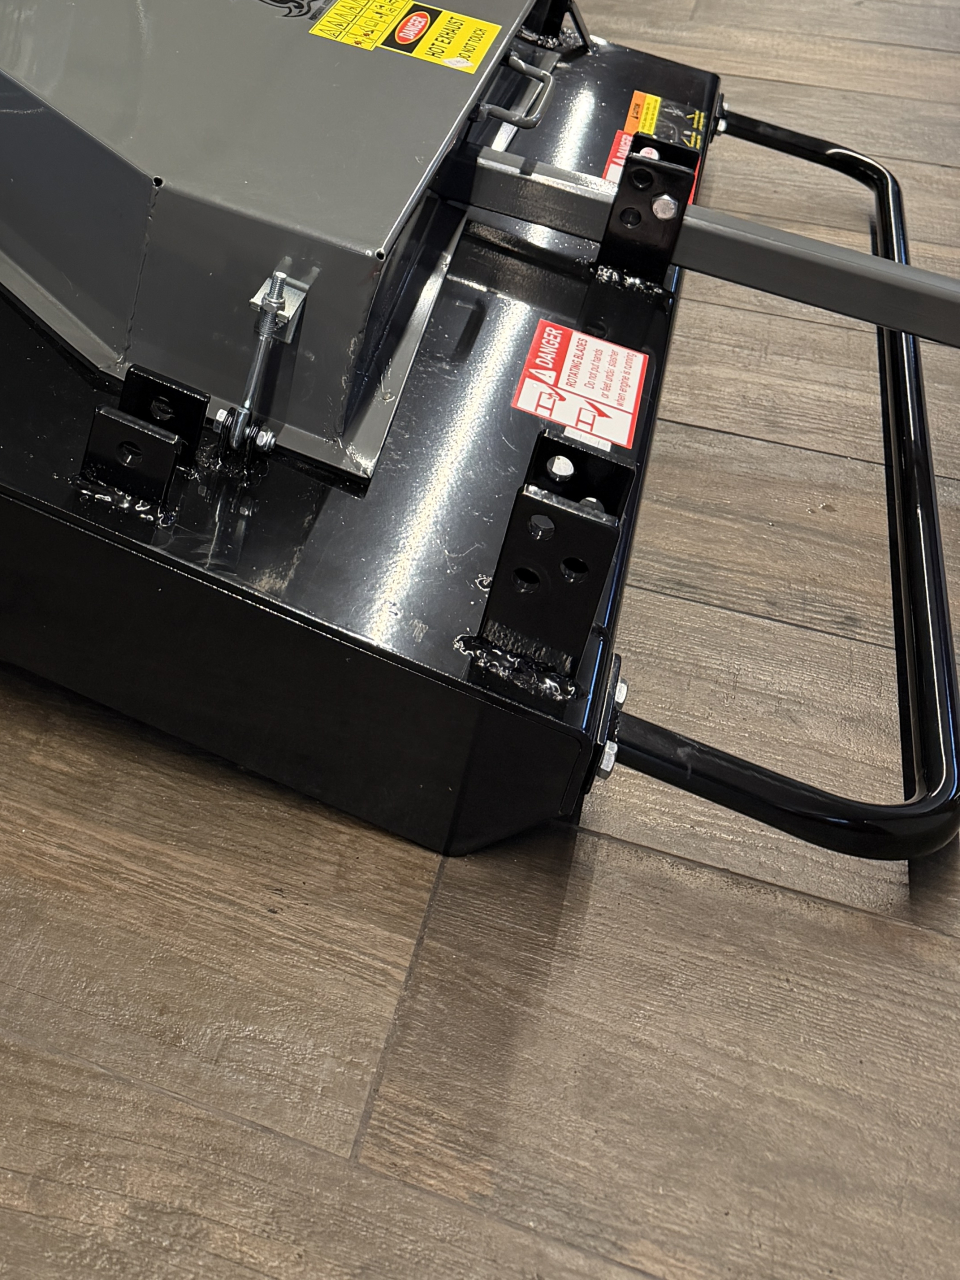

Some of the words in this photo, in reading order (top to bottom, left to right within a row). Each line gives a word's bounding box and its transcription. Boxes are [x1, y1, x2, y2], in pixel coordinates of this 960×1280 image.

[399, 15, 427, 39] DANGER
[425, 42, 447, 58] HOT
[440, 16, 465, 44] EXHAUST
[462, 41, 477, 54] NOT
[470, 27, 487, 44] TOUCH
[535, 326, 563, 368] DANGER
[573, 338, 588, 360] BLADES
[592, 348, 603, 363] hands
[590, 362, 600, 373] put
[607, 349, 618, 368] slasher
[624, 352, 637, 370] running
[565, 359, 582, 388] ROTATING
[588, 371, 597, 381] not
[604, 366, 615, 382] under
[584, 380, 596, 389] Do
[600, 381, 612, 392] feet
[619, 375, 631, 393] engine
[616, 392, 626, 407] when
